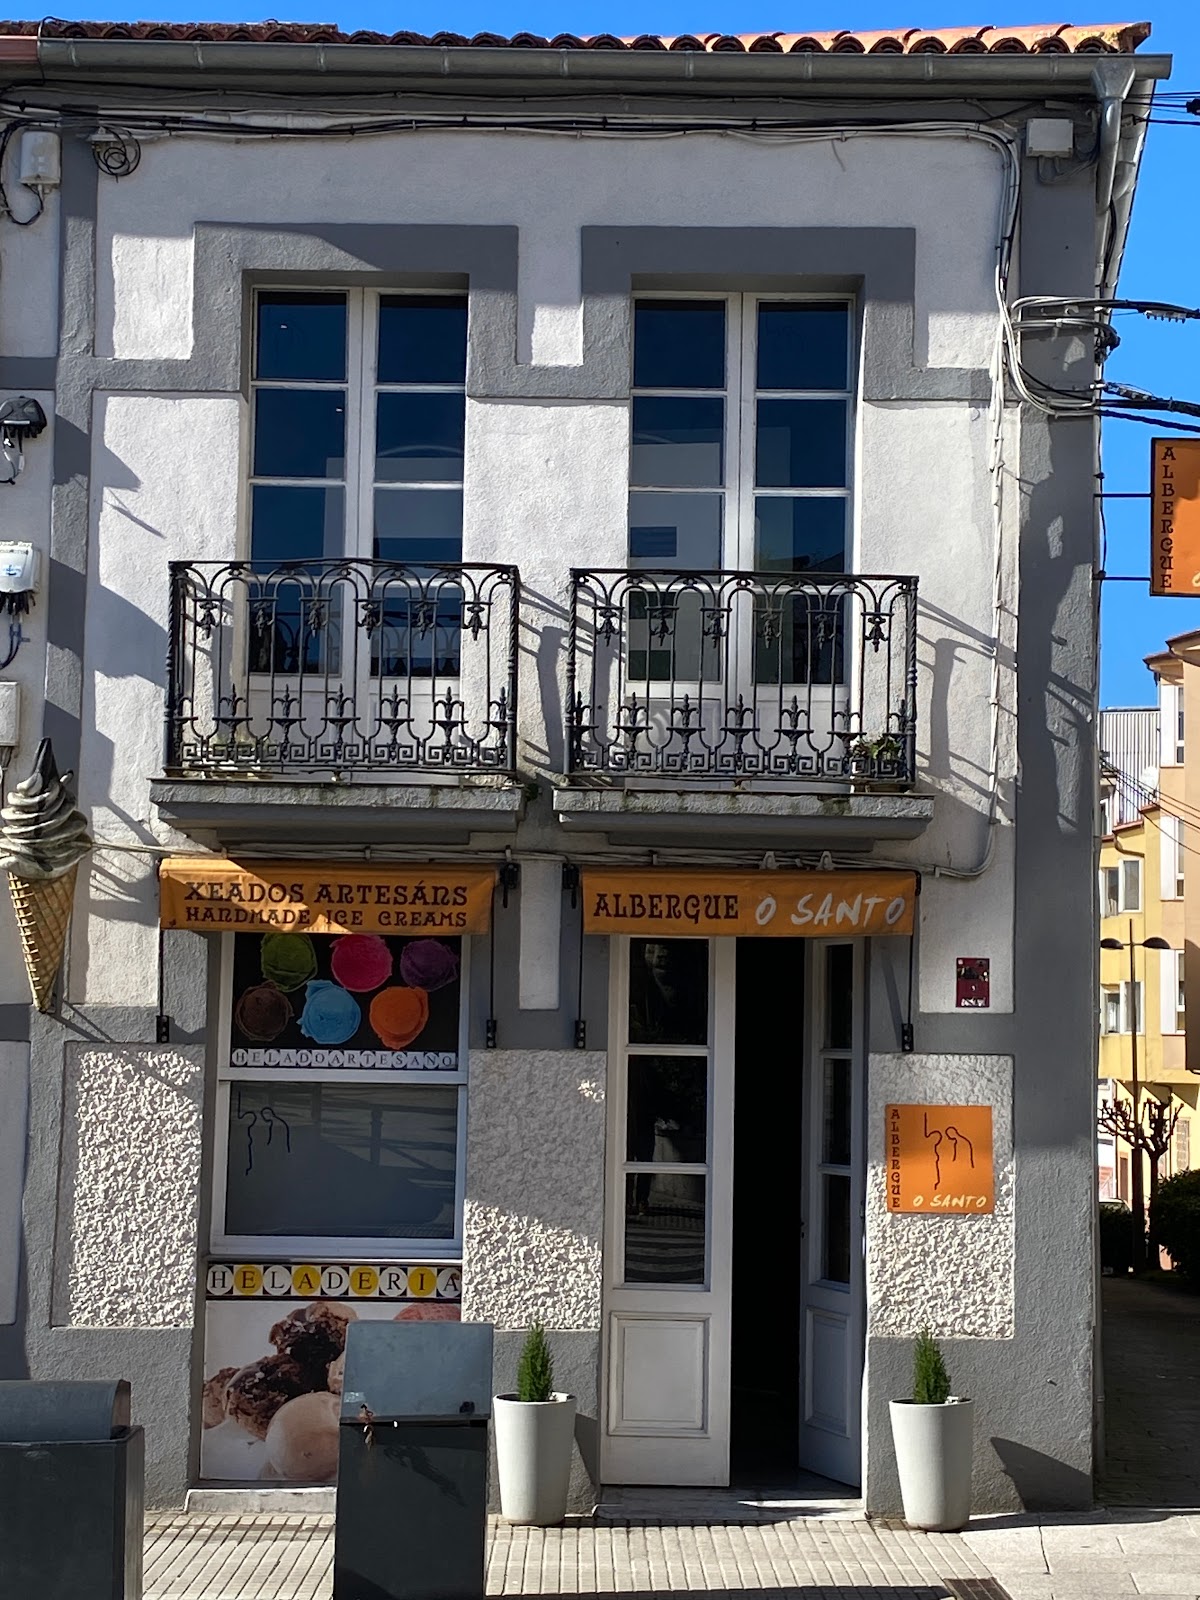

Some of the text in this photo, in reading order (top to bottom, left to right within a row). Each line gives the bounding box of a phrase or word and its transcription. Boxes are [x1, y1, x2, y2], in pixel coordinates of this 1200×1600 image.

[1160, 447, 1176, 588] ALBERGUE
[184, 879, 468, 907] XEADOS ARTESÁNS
[185, 907, 468, 928] HANDMADE ICE CREAMS
[593, 891, 906, 928] ALBERGUE O SANTO
[891, 1109, 901, 1208] ALBERGUE
[912, 1193, 987, 1208] O SANTO
[209, 1270, 459, 1292] HELADERIA
